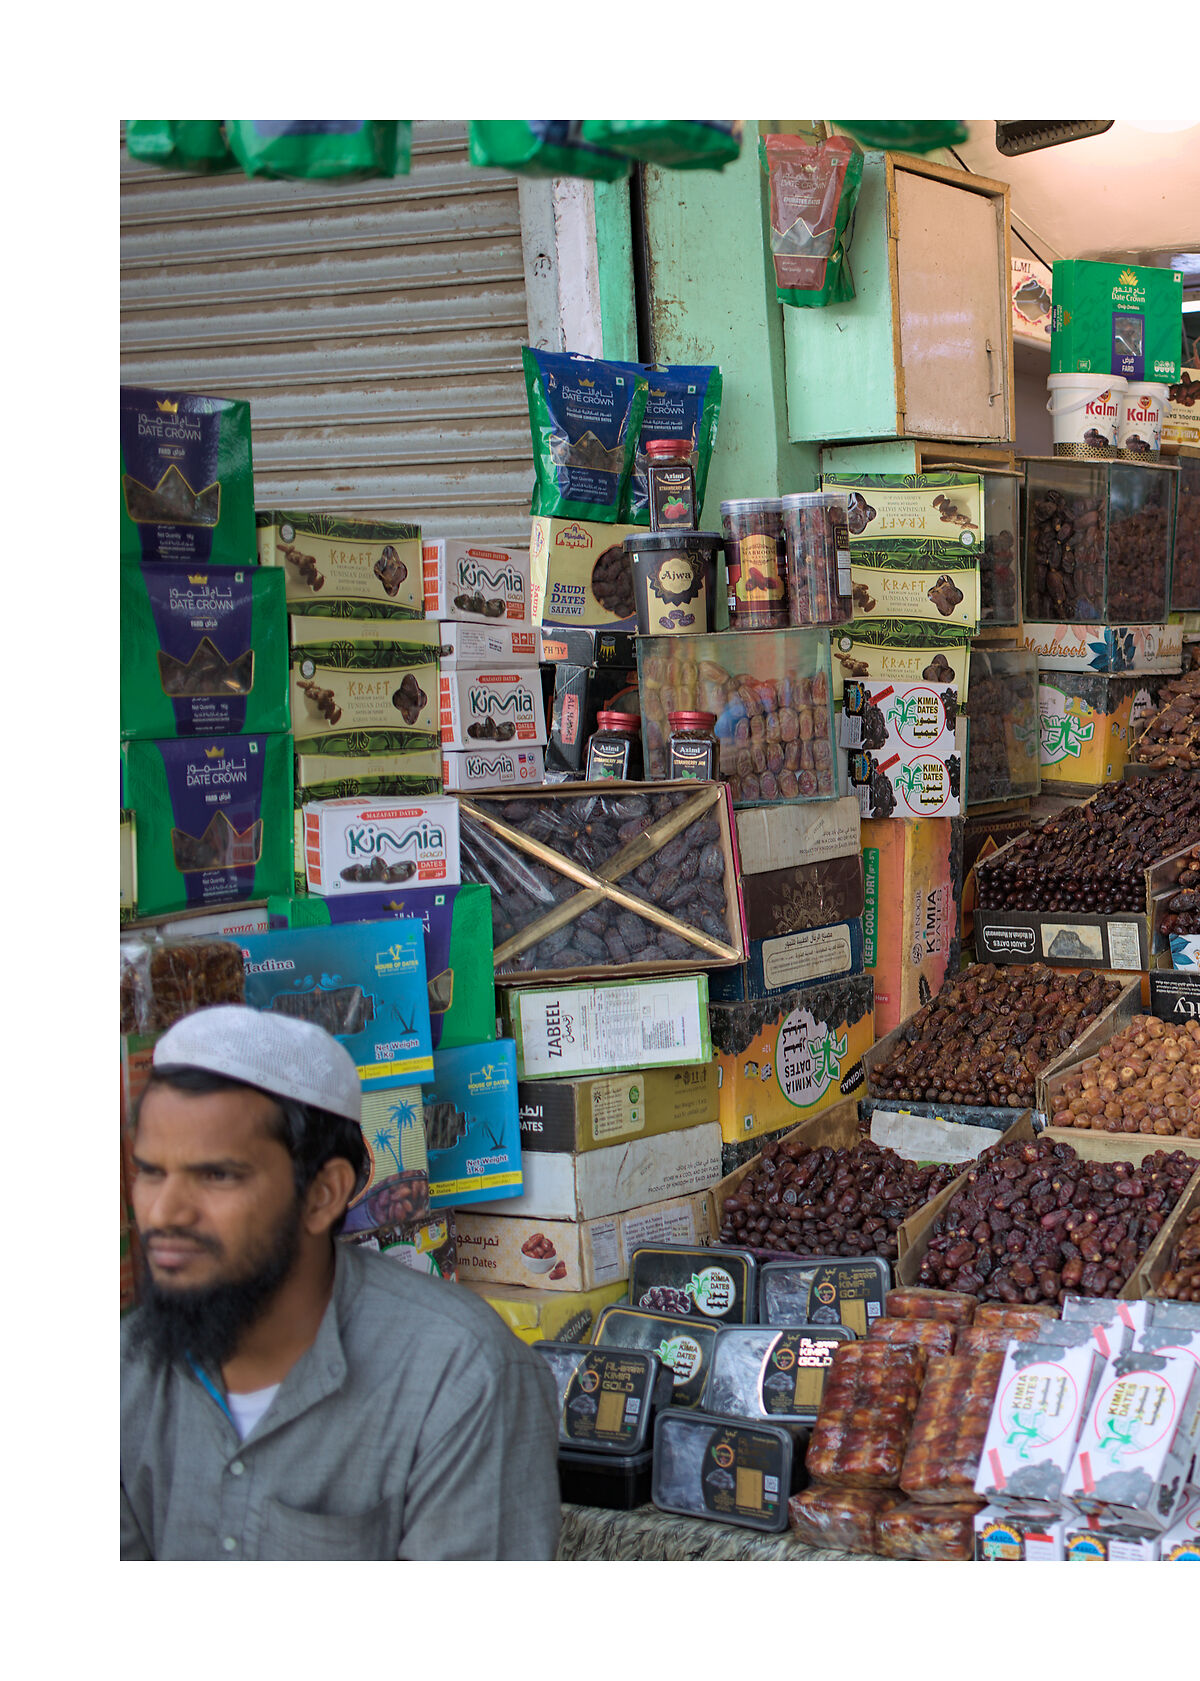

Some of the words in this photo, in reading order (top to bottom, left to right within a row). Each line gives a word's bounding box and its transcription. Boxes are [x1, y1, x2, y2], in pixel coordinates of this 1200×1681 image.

[1111, 293, 1125, 301] Date
[1126, 294, 1145, 303] Crown
[1122, 365, 1134, 373] FARD
[562, 392, 583, 401] DATE
[583, 396, 614, 406] CROWN
[653, 405, 685, 415] CROWN
[1086, 403, 1118, 417] Kalmi
[1127, 408, 1159, 423] Kalmi
[138, 425, 163, 437] DATE
[165, 427, 202, 441] CROWN
[879, 516, 927, 530] KRAFT
[329, 549, 373, 567] KRAFT
[660, 568, 692, 582] Ajwa
[553, 582, 586, 594] SAUDI
[882, 578, 927, 593] KRAFT
[169, 599, 194, 610] DATE
[196, 599, 234, 611] CROWN
[551, 593, 587, 605] DATES
[551, 605, 583, 615] SAFAWI
[1023, 636, 1088, 659] Mashrook
[882, 655, 922, 671] KRAFT
[348, 680, 391, 697] KRAFT
[917, 696, 939, 706] KIMIA
[917, 705, 939, 714] DATES
[600, 744, 620, 753] Azimi
[679, 745, 701, 754] Azimi
[922, 764, 944, 773] KIMIA
[186, 774, 211, 787] DATE
[211, 772, 247, 784] CROWN
[922, 773, 944, 781] DATES
[366, 811, 398, 819] MAZAFATI
[399, 809, 419, 817] DATES
[420, 860, 443, 869] DATES
[866, 873, 875, 895] DRY
[865, 897, 875, 905] &
[914, 890, 922, 926] NOOR
[865, 907, 875, 936] COOL
[922, 890, 936, 954] KIMIA
[914, 930, 921, 941] AL
[992, 939, 1010, 947] DATES
[1010, 940, 1027, 948] SAUDI
[864, 938, 874, 964] KEEP
[374, 962, 393, 971] HOUSE
[401, 959, 419, 967] DATES
[874, 994, 889, 1002] Here
[545, 1000, 564, 1059] ZABEEL
[374, 1044, 389, 1052] Net
[391, 1039, 420, 1051] Weight
[382, 1051, 395, 1060] Kg
[784, 1059, 811, 1078] DATES
[467, 1082, 486, 1090] HOUSE
[785, 1076, 812, 1095] KIMIA
[465, 1159, 480, 1167] Net
[481, 1153, 509, 1165] Weight
[473, 1166, 485, 1175] Kg
[472, 1256, 498, 1269] Dates
[710, 1275, 730, 1283] KIMIA
[710, 1282, 730, 1290] DATES
[839, 1288, 871, 1299] GOLD
[678, 1344, 698, 1353] KIMIA
[676, 1351, 697, 1360] DATES
[798, 1356, 834, 1367] GOLD
[602, 1381, 634, 1392] GOLD
[1012, 1375, 1027, 1409] KIMIA
[1023, 1375, 1039, 1410] DATES
[1107, 1381, 1127, 1416] KIMIA
[1119, 1383, 1137, 1417] DATES
[989, 1534, 1014, 1544] KASCO
